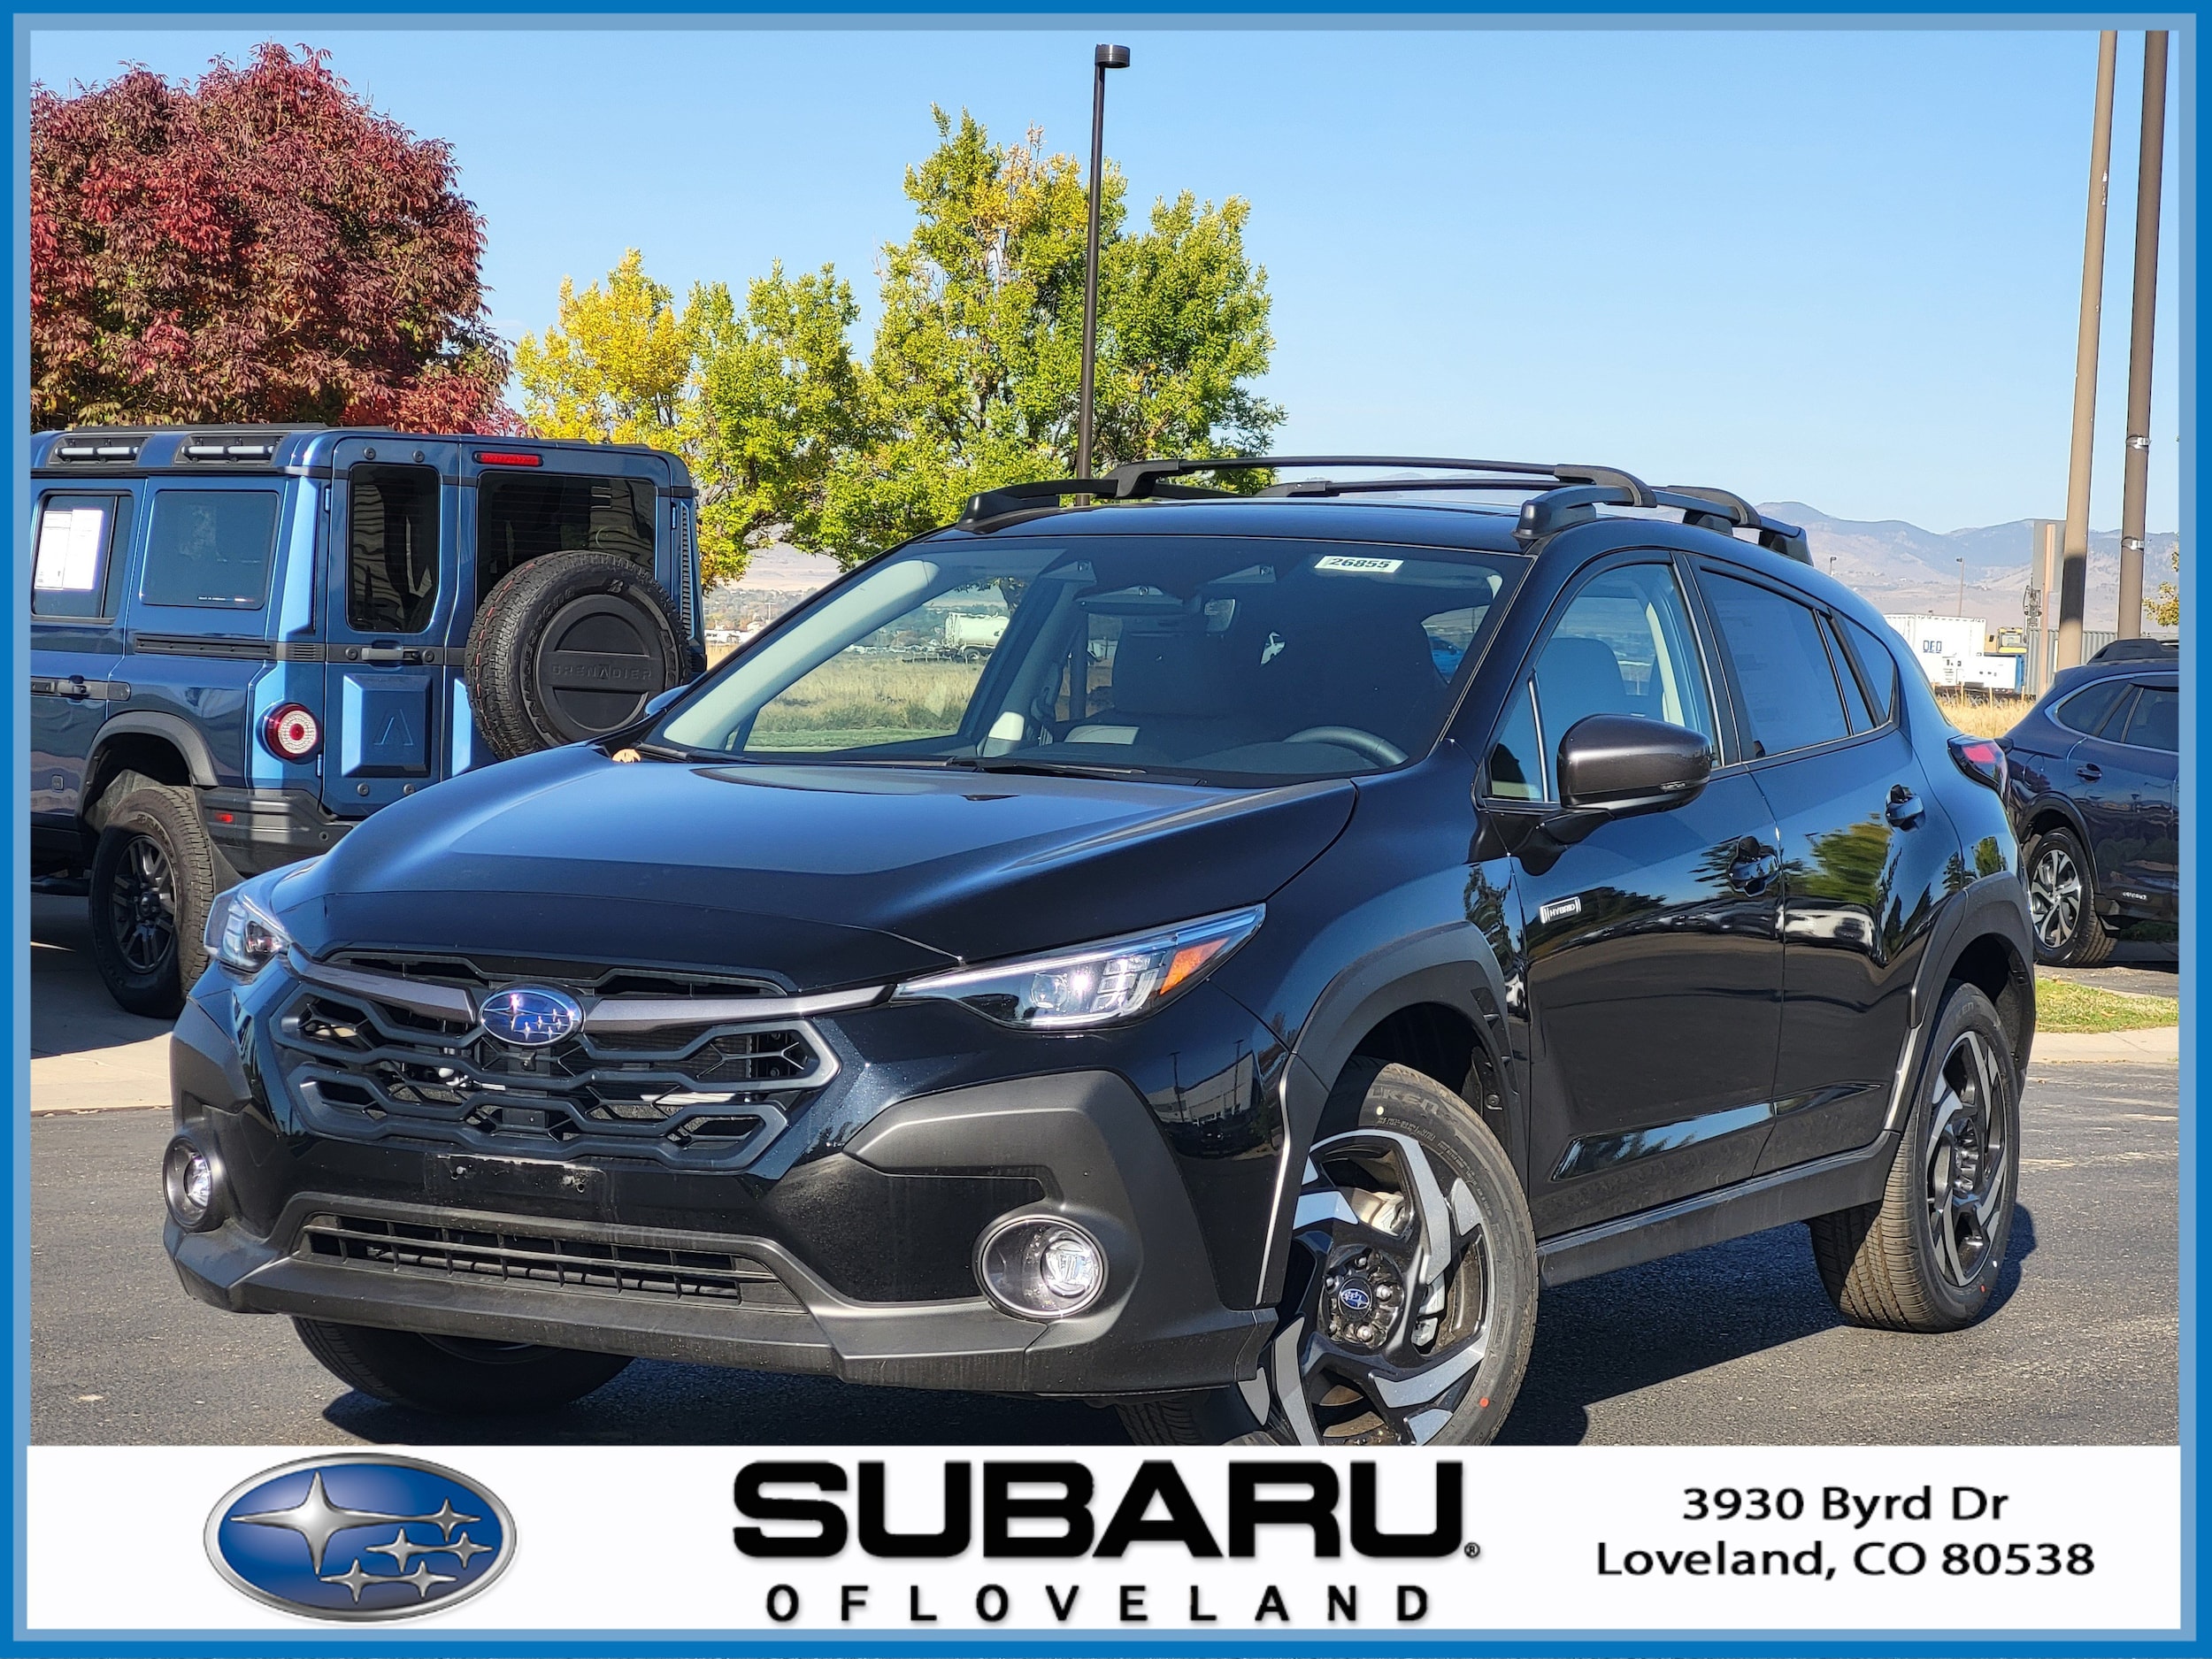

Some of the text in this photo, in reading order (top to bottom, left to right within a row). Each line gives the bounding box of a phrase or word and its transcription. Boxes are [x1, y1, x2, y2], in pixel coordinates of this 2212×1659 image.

[1329, 557, 1391, 568] 26855
[552, 664, 653, 680] GRENADIER
[1549, 903, 1576, 917] HYBRID
